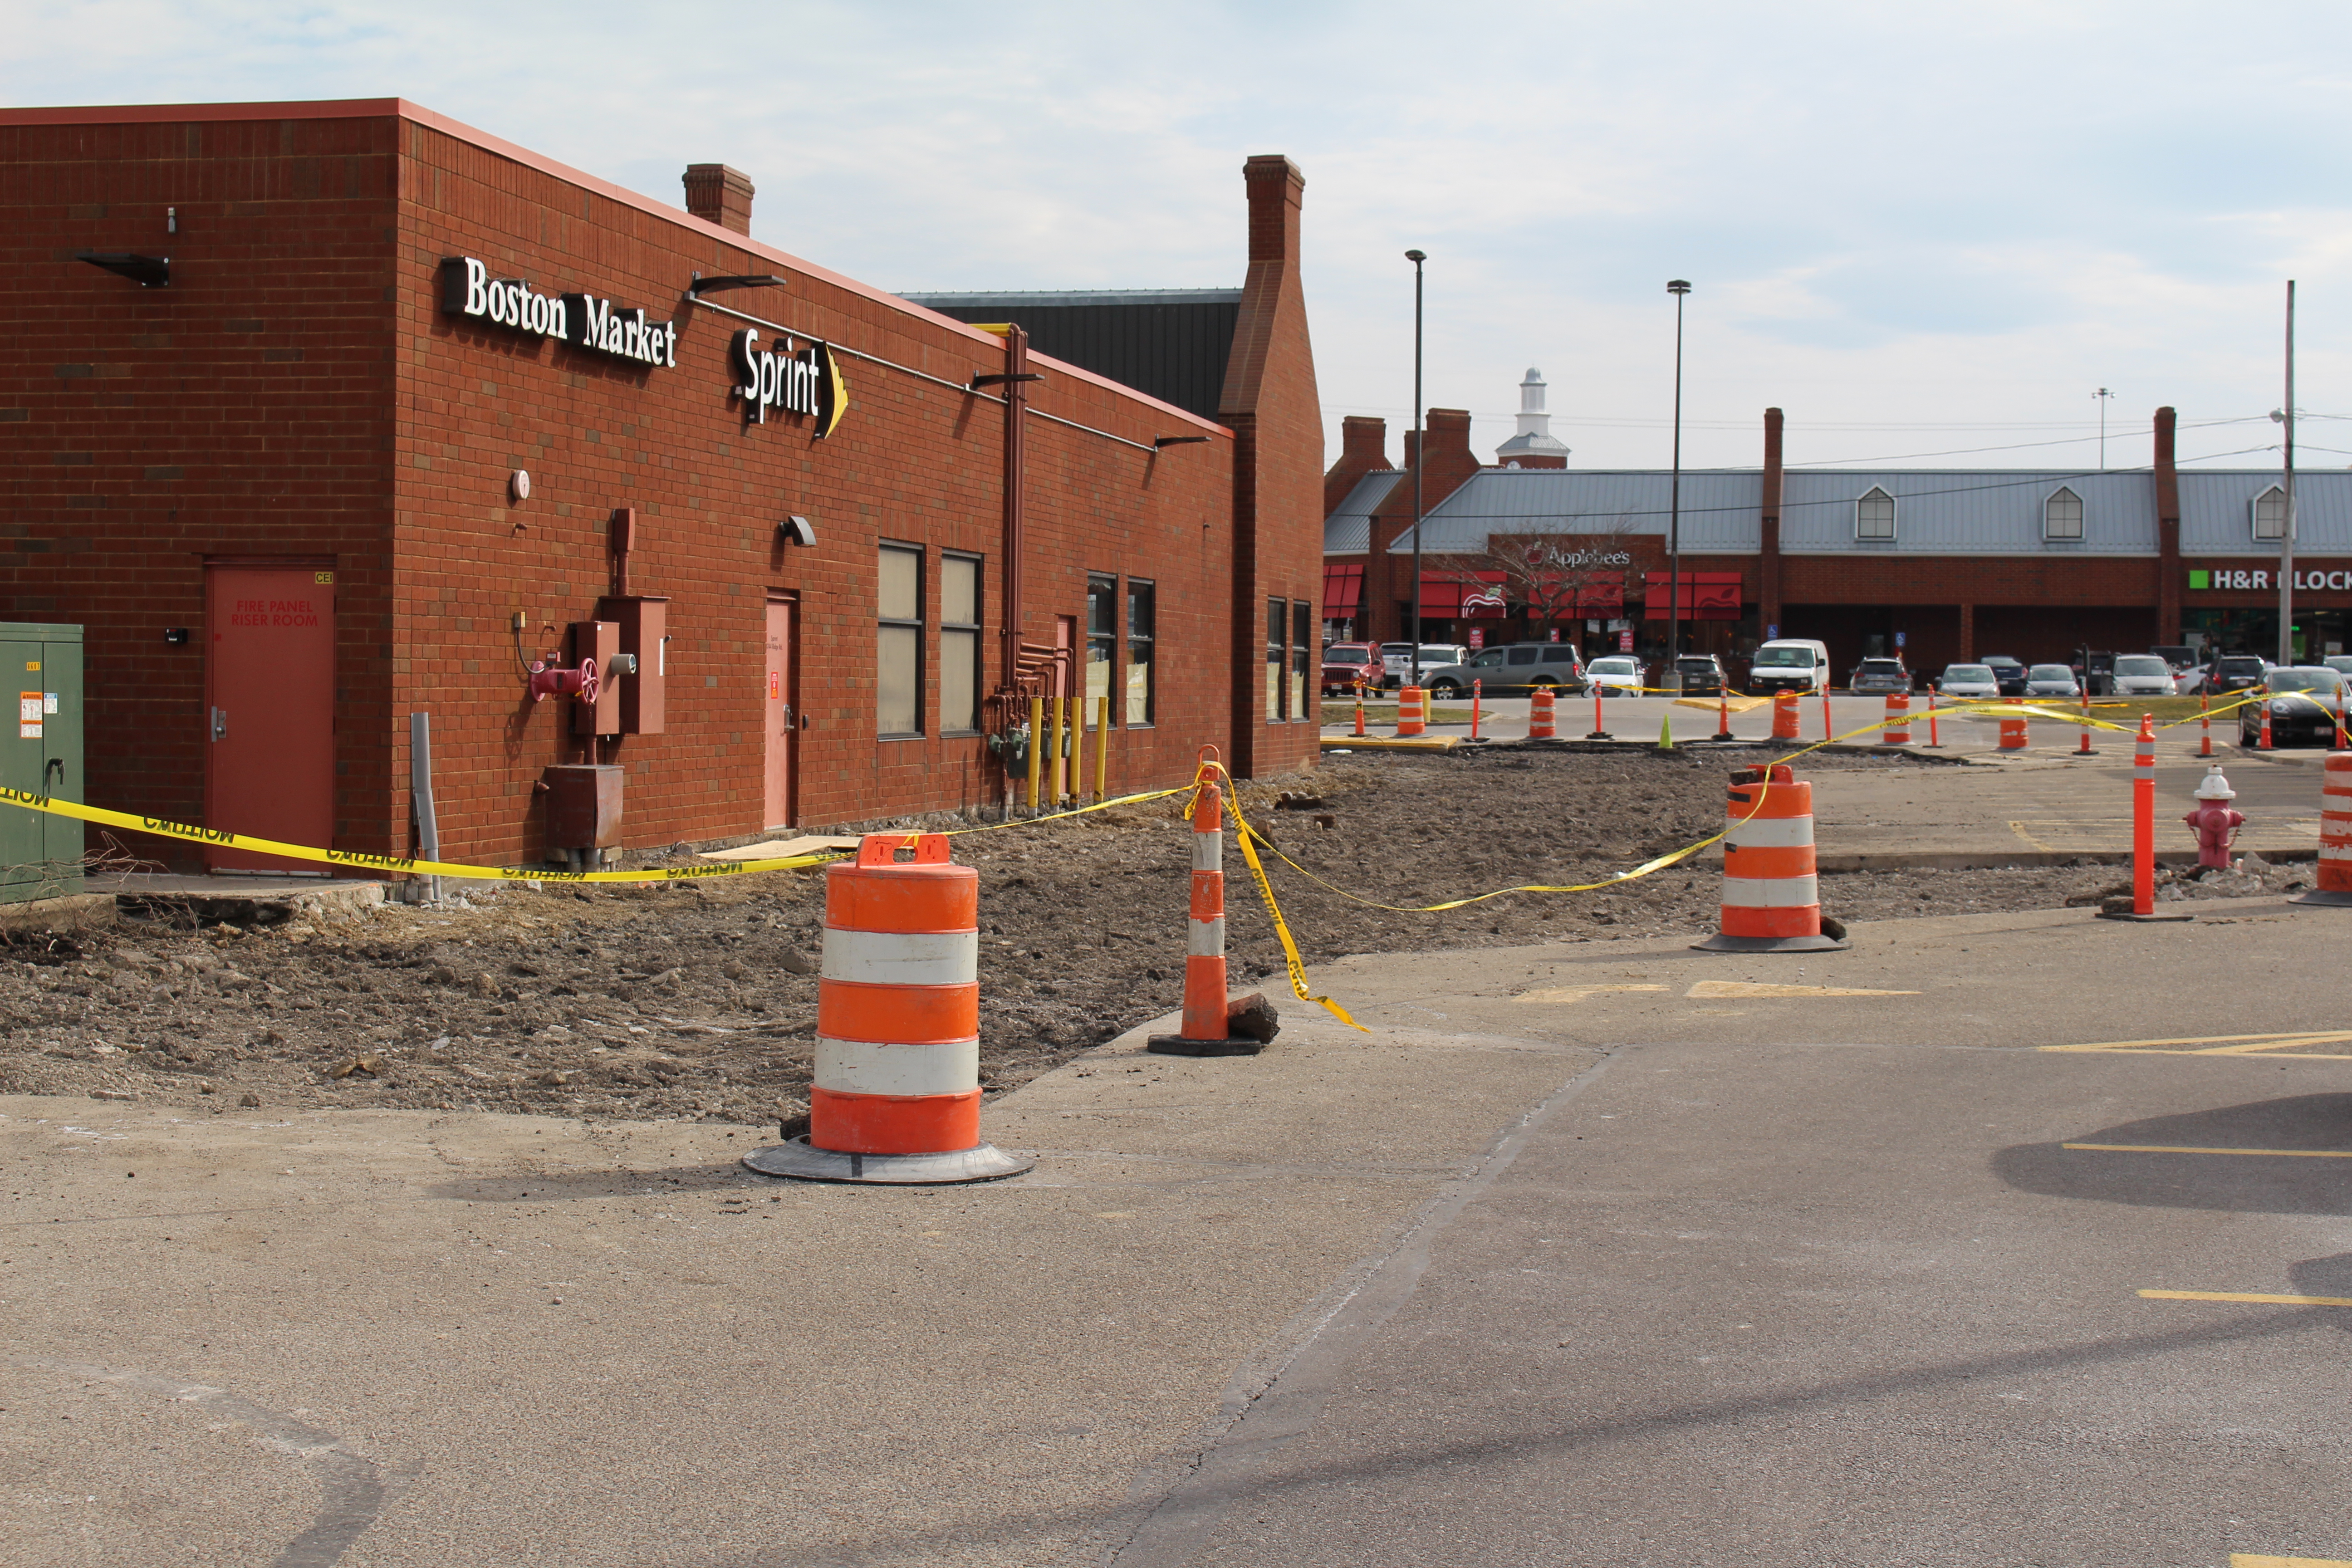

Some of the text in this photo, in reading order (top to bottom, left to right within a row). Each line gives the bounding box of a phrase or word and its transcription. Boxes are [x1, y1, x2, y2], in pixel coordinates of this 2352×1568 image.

[465, 257, 677, 368] Boston Market
[745, 328, 819, 424] Sprint
[1548, 547, 1630, 567] Applebee's
[316, 573, 333, 583] CEI
[2214, 570, 2268, 588] H&R
[237, 600, 314, 612] FIRE PANEL
[231, 614, 318, 627] RISER ROOM
